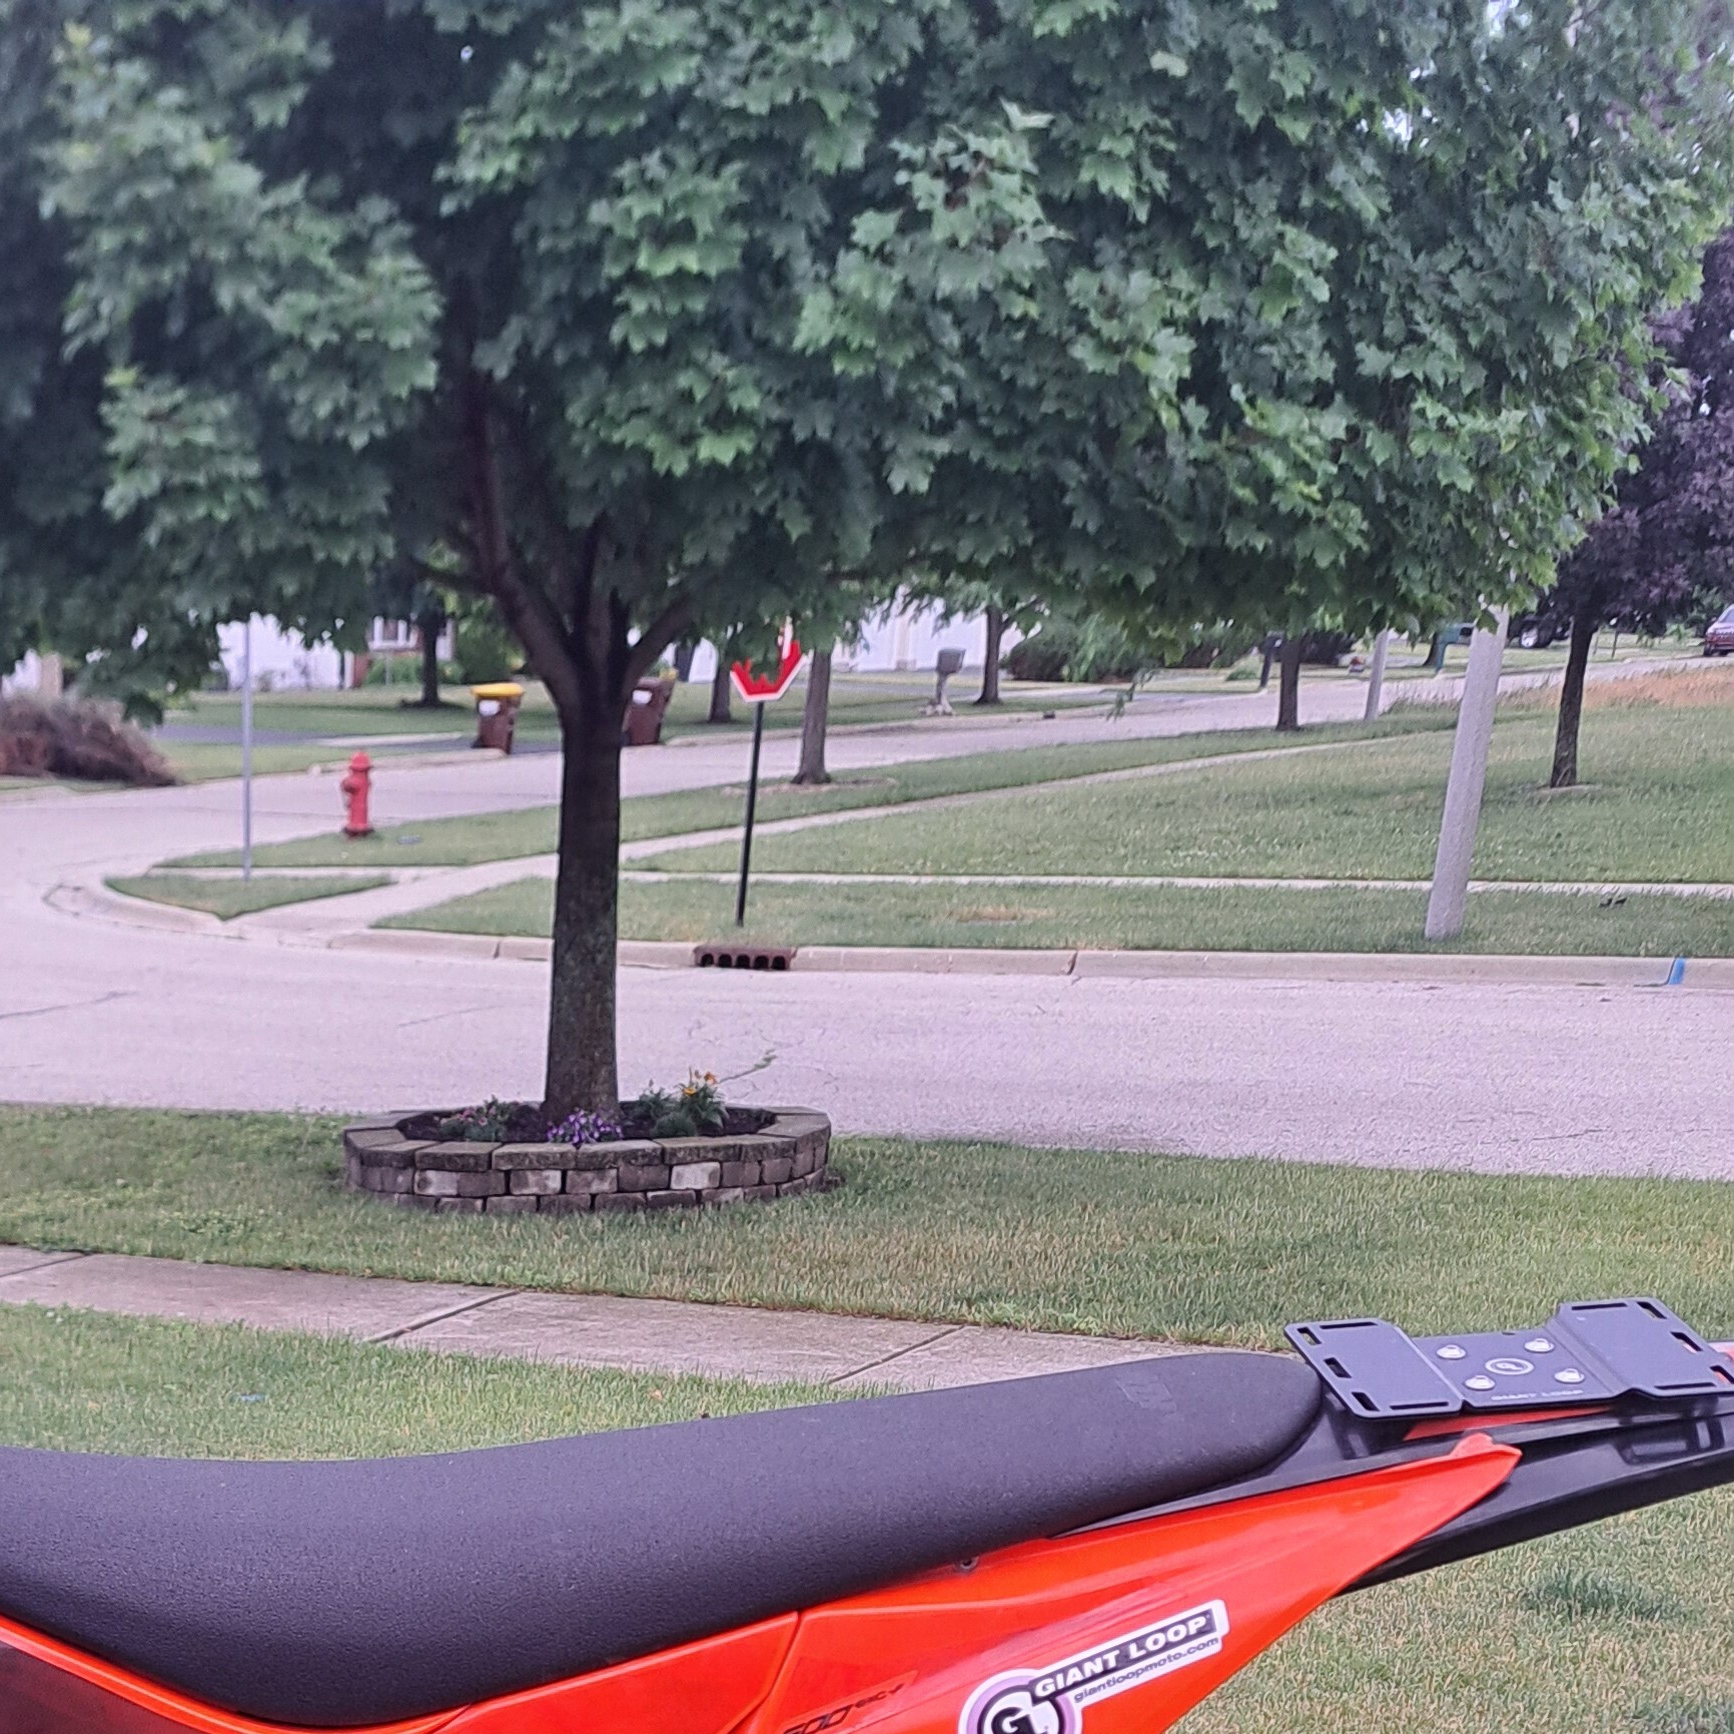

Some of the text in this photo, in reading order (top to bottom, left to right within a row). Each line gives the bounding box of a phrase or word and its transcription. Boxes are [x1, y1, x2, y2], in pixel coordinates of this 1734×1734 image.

[1034, 1616, 1207, 1697] GIANT LOOP
[1073, 1637, 1220, 1704] giantloopmoto.com
